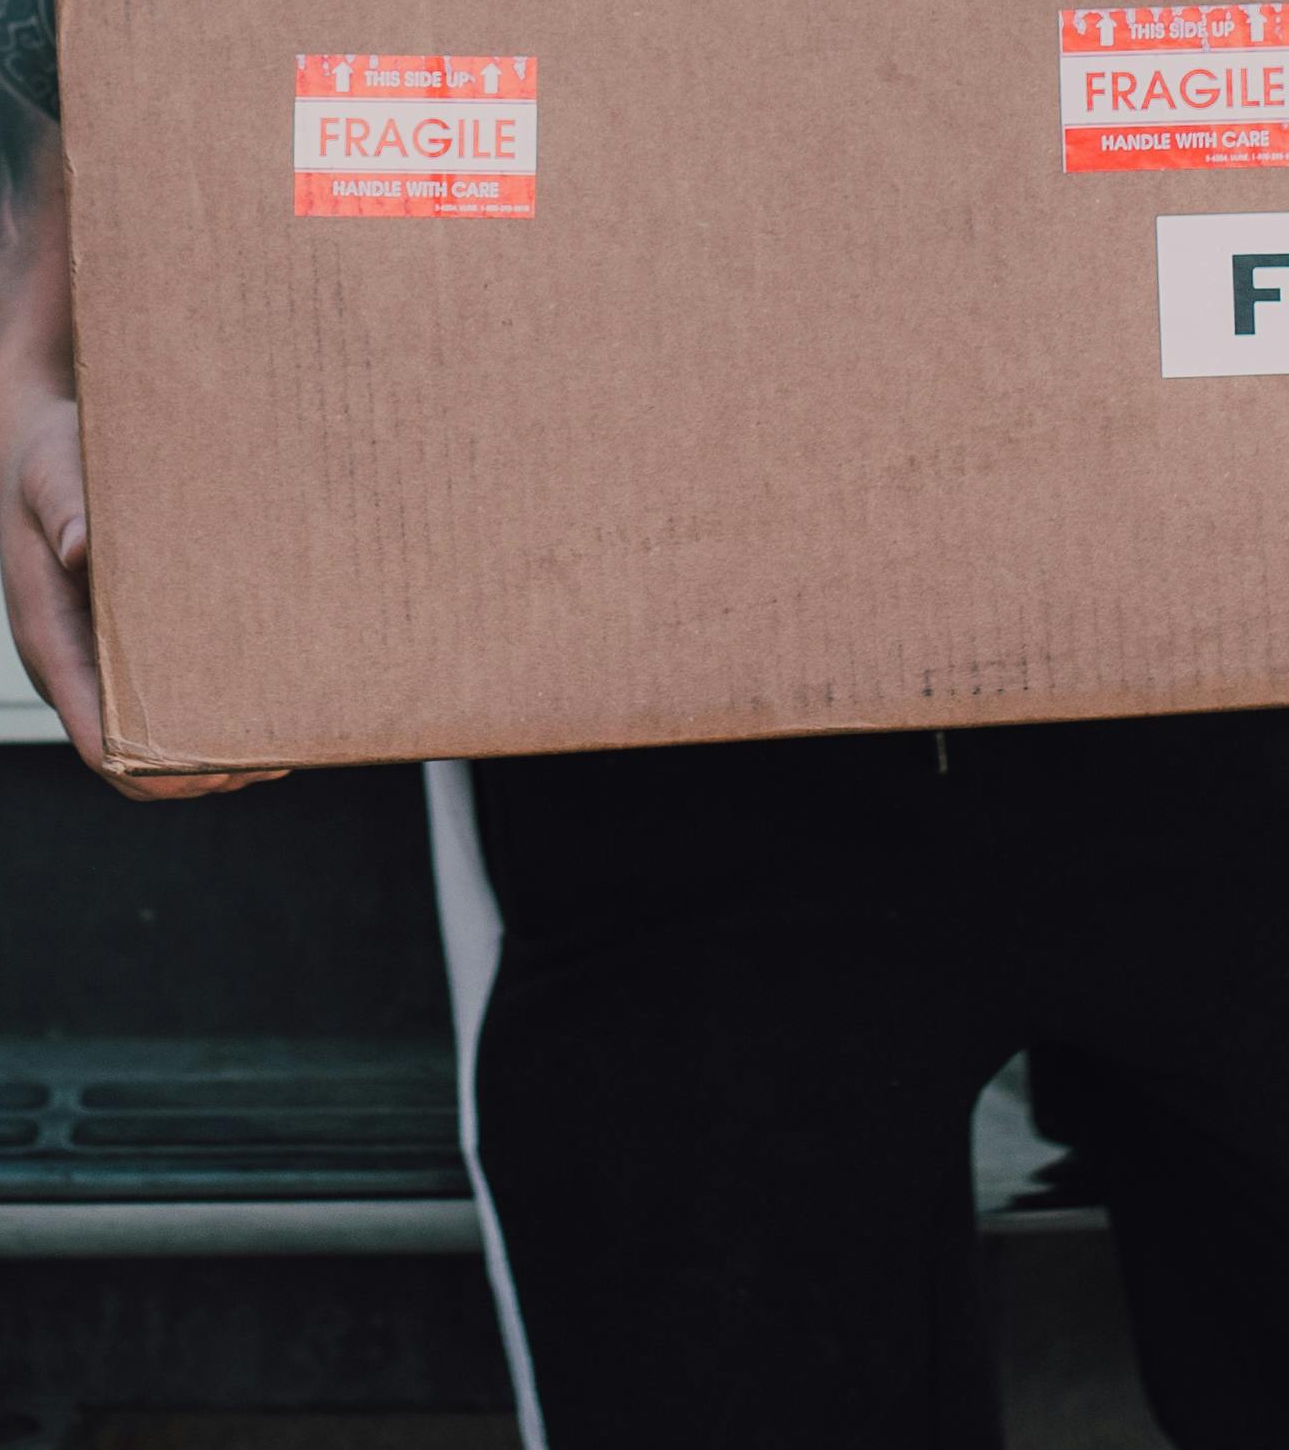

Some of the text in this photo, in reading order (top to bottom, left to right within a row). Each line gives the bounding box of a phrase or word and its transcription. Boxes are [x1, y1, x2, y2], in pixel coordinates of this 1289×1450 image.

[1129, 20, 1235, 40] THIS SIDE UP
[365, 70, 469, 88] THIS SIDE UP
[1086, 66, 1285, 111] FRAGILE
[319, 117, 516, 159] FRAGILE
[1101, 130, 1270, 151] HANDLE WITH CARE
[332, 180, 500, 199] HANDLE WITH CARE
